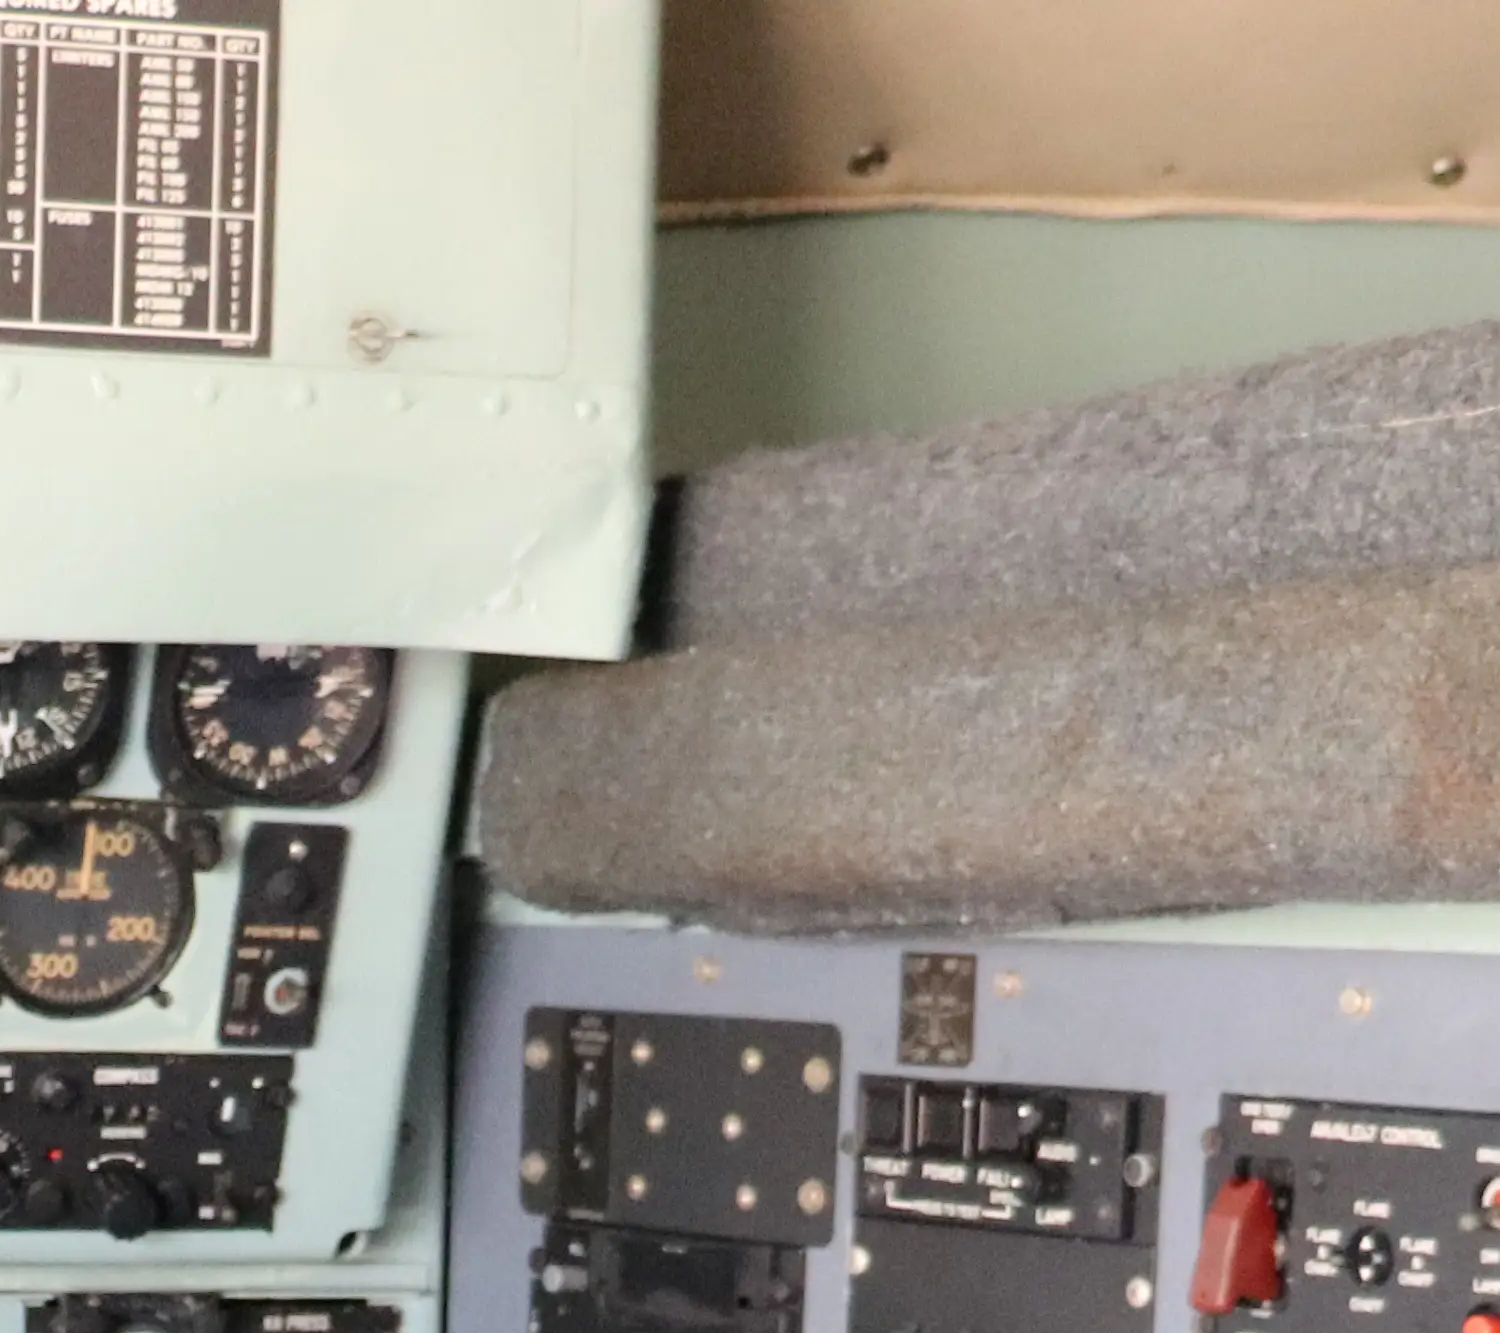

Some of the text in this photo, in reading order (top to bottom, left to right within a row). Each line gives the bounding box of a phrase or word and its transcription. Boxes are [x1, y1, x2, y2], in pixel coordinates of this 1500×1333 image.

[3, 865, 56, 892] 400
[106, 915, 157, 944] 200
[27, 955, 79, 980] 300
